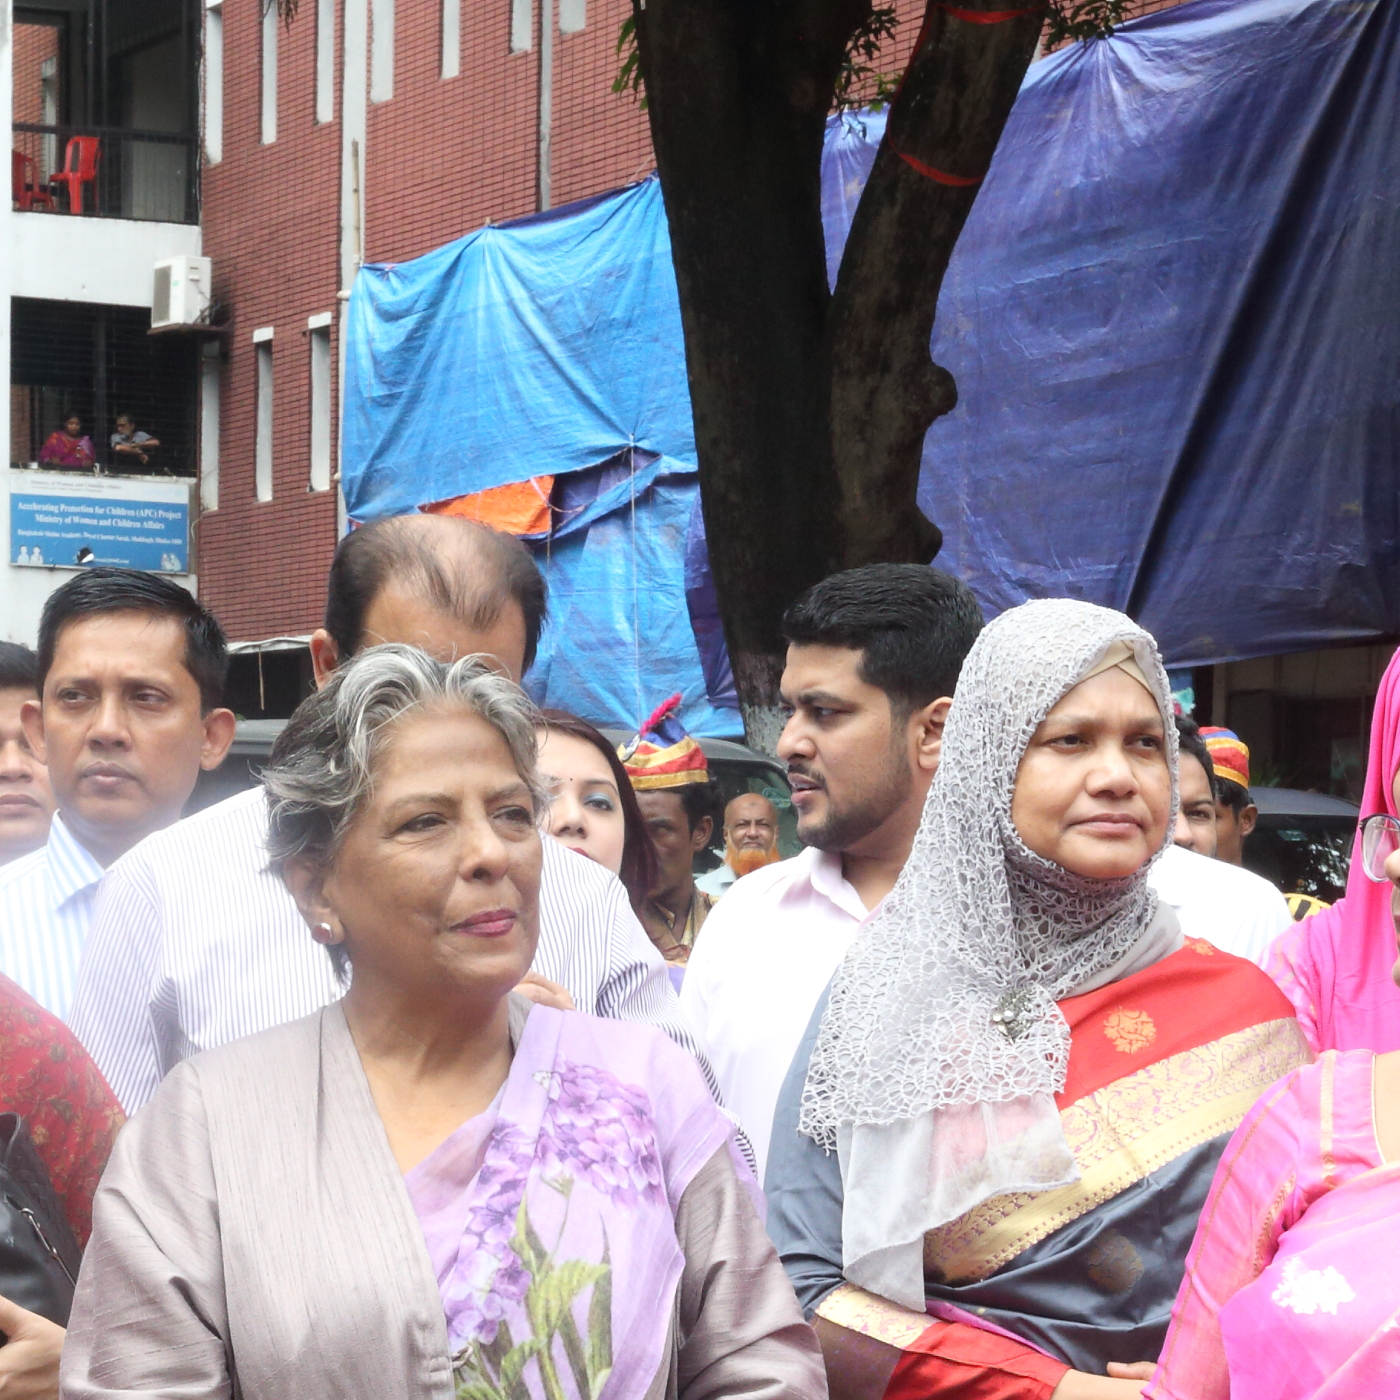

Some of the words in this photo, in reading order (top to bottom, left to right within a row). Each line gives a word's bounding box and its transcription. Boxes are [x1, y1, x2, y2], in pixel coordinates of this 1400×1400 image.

[18, 502, 59, 513] Accelerating
[61, 503, 93, 513] Protection
[95, 506, 104, 514] for
[106, 507, 135, 516] Children
[136, 508, 157, 518] (APC)
[159, 510, 182, 520] Project
[36, 514, 62, 524] Ministry
[73, 516, 97, 525] Women
[99, 518, 111, 526] and
[113, 518, 140, 528] Children
[143, 520, 165, 530] Affairs
